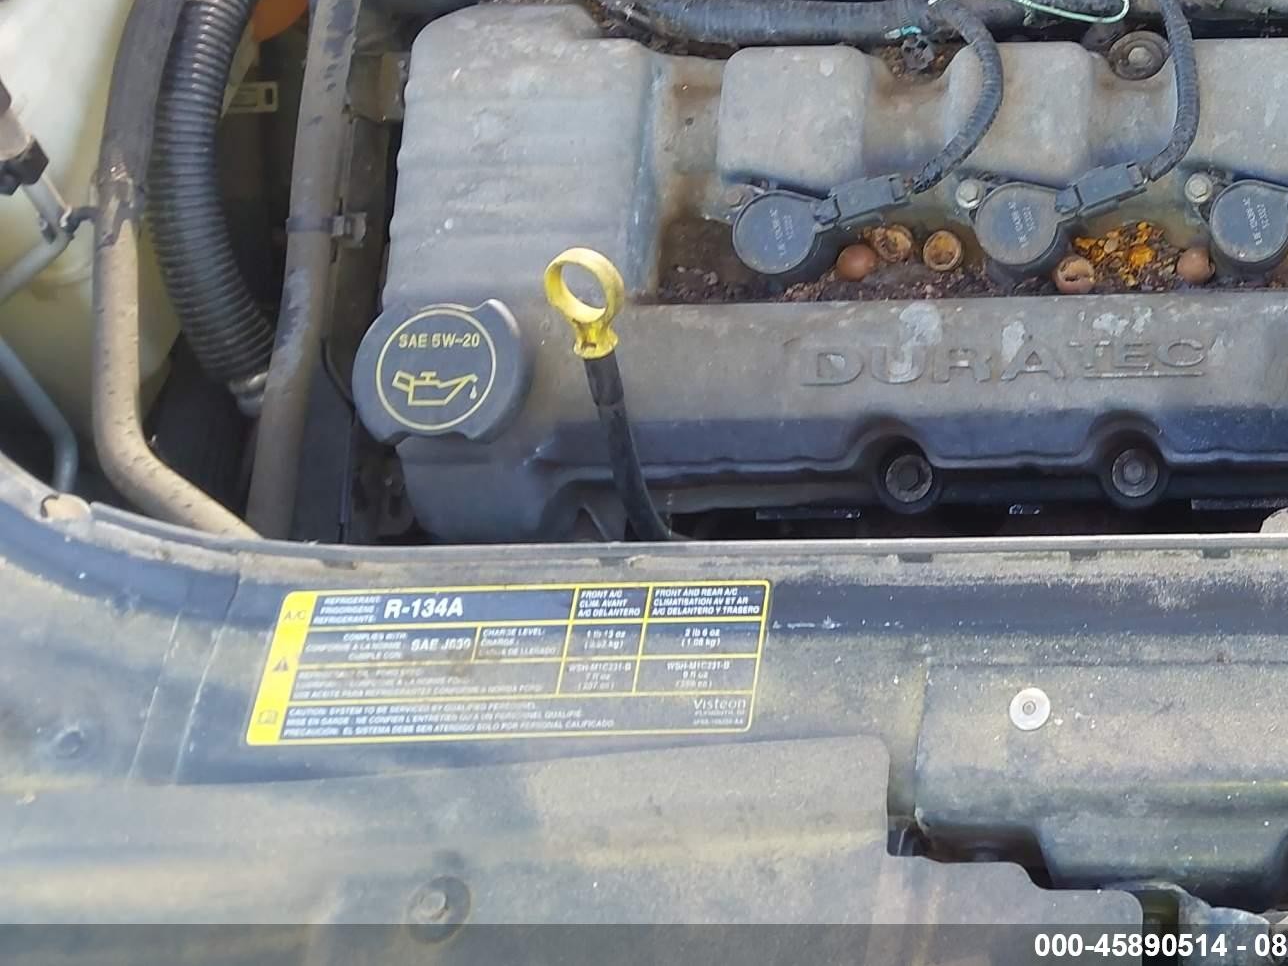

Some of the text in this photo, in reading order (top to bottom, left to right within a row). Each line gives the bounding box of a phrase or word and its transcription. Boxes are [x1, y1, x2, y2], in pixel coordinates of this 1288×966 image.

[399, 333, 428, 348] SAE
[801, 341, 1207, 385] DURATEC
[580, 590, 623, 598] FRONT A/C
[655, 588, 681, 596] FRONT
[683, 588, 700, 596] AND
[701, 588, 722, 596] REAR
[383, 597, 463, 619] R-134A
[602, 599, 627, 607] AVANT
[593, 608, 640, 617] DELANTERO
[667, 607, 715, 615] DELANTERO
[411, 638, 439, 651] SAE
[694, 699, 746, 710] Visteon
